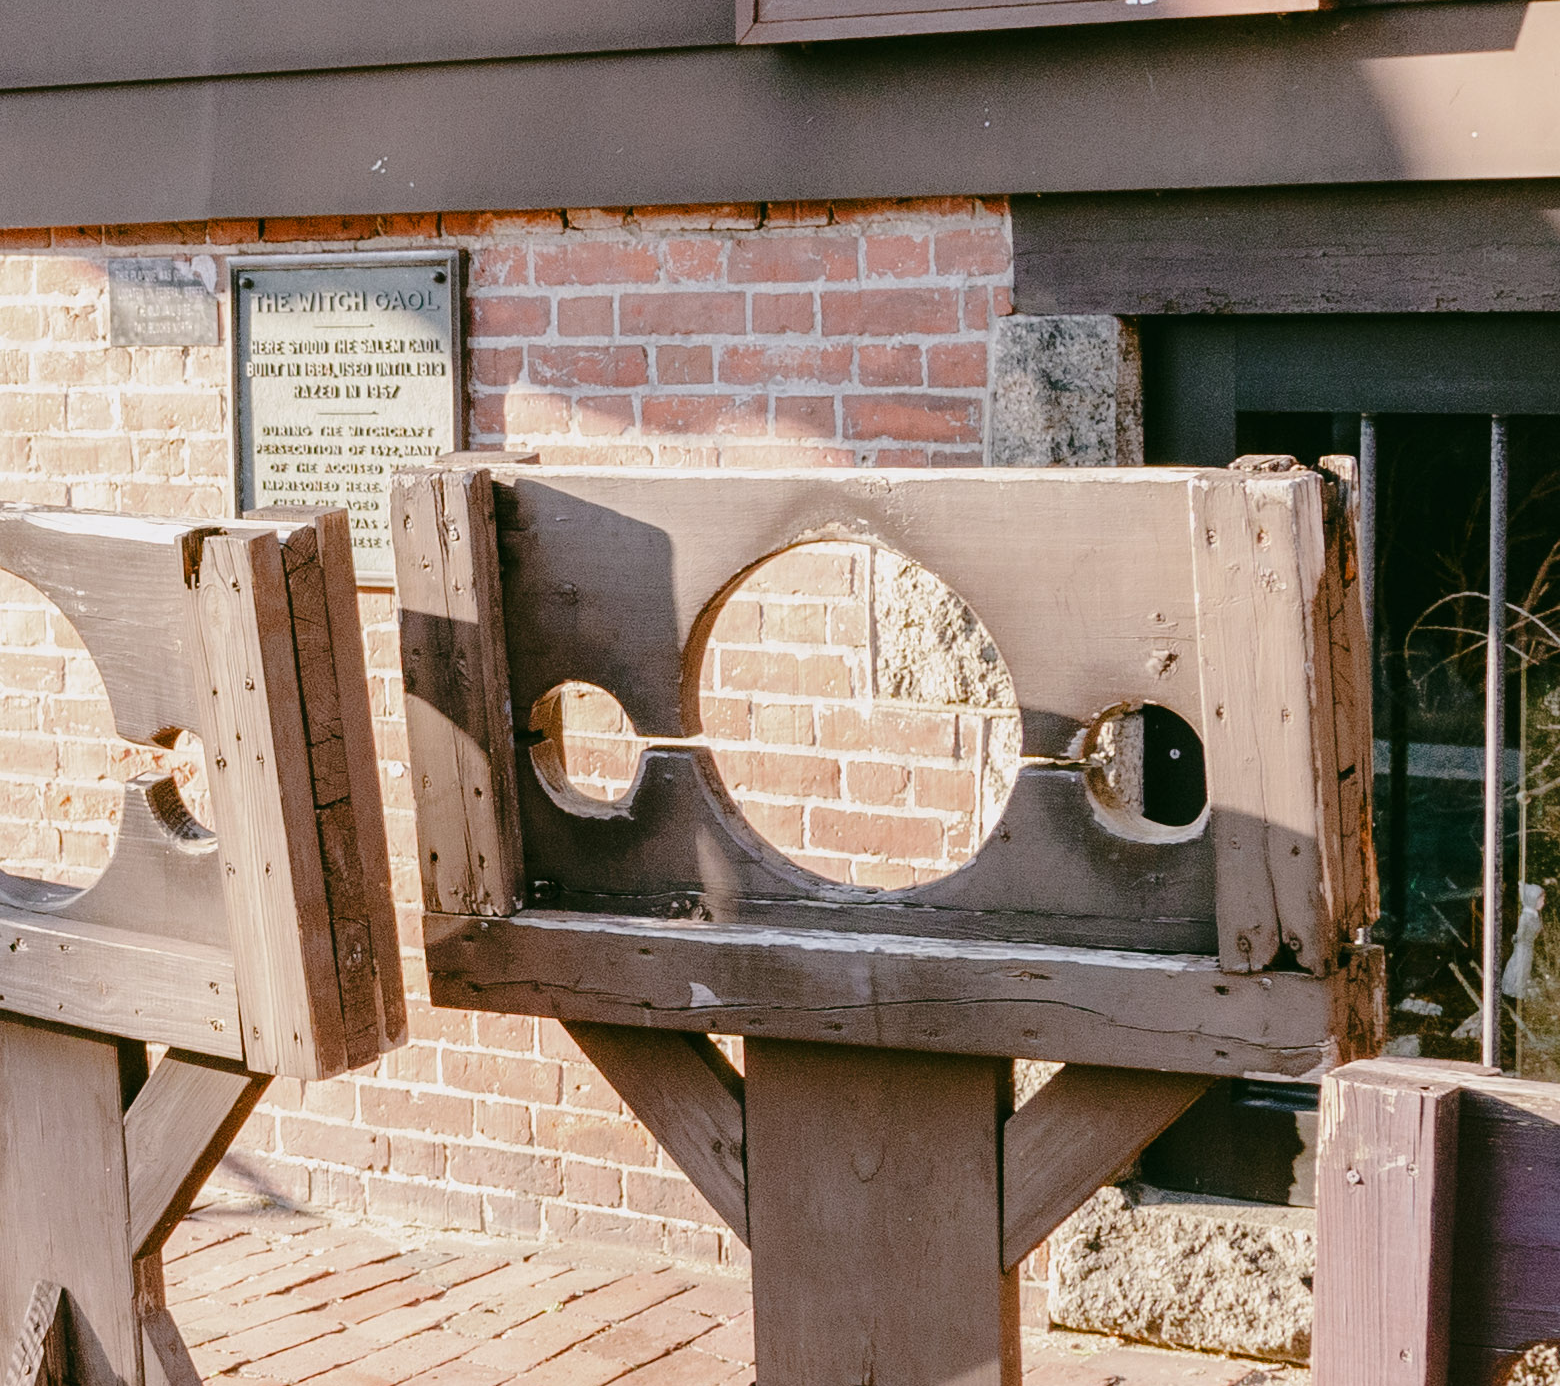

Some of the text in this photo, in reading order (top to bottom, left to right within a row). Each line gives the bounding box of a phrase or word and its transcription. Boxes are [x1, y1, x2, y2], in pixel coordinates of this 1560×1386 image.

[251, 289, 440, 313] THE WITCH GAOL
[251, 338, 444, 355] HERE STOOD THE SALEM GAOL
[246, 362, 282, 377] BUILT
[287, 362, 301, 377] IN
[338, 362, 371, 377] USED
[376, 362, 415, 377] UNTIL
[416, 362, 446, 377] 1813
[293, 384, 340, 399] RAZED
[346, 384, 361, 399] IN
[262, 425, 435, 438] DURING THE WITCHCRAFT
[256, 443, 343, 456] PERSECUTION
[348, 444, 366, 456] OF
[403, 443, 442, 457] MANY
[270, 462, 290, 474] OF
[296, 462, 319, 474] THE
[324, 462, 384, 475] ACCUSED
[262, 479, 340, 492] IMPRISONED
